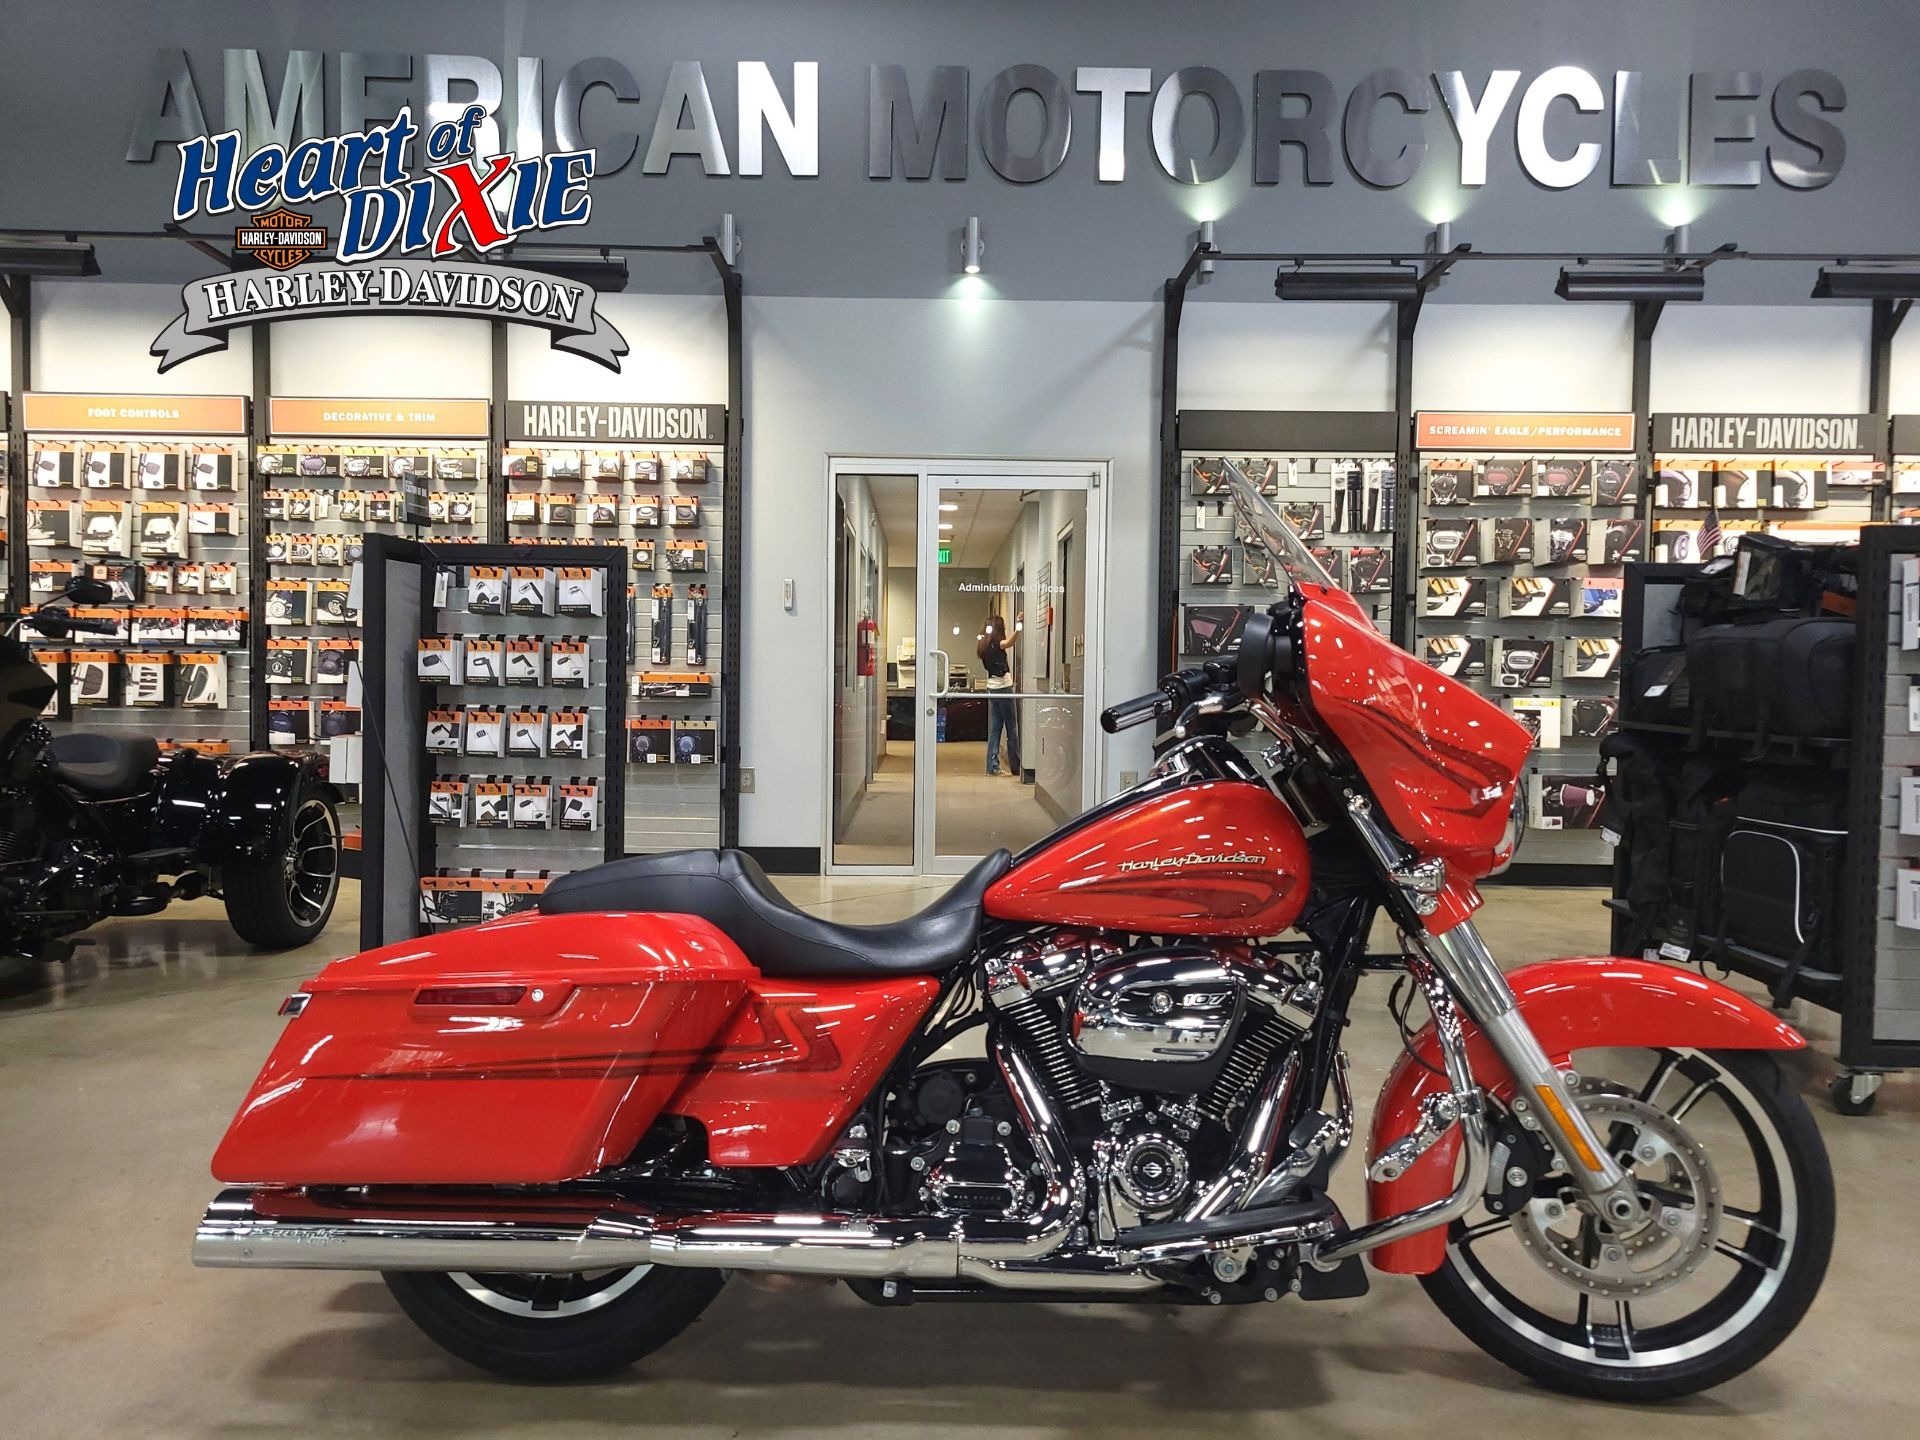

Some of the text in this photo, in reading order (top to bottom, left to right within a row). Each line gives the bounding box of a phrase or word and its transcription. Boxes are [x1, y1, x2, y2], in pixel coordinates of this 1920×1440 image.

[125, 48, 1847, 190] AMERICAN MOTORCYCLES
[87, 407, 180, 419] FOOT CONTROLS
[323, 411, 436, 423] DECORATIVE & TRIM
[522, 404, 708, 440] HARLEY-DAVIDSON
[1429, 425, 1622, 437] SCREAMIN' EAGLE/PERFORMANCE
[1671, 417, 1859, 450] HARLEY-DAVIDSON
[938, 550, 950, 563] XIT
[958, 582, 1025, 593] Administrative
[1183, 993, 1226, 1007] 107
